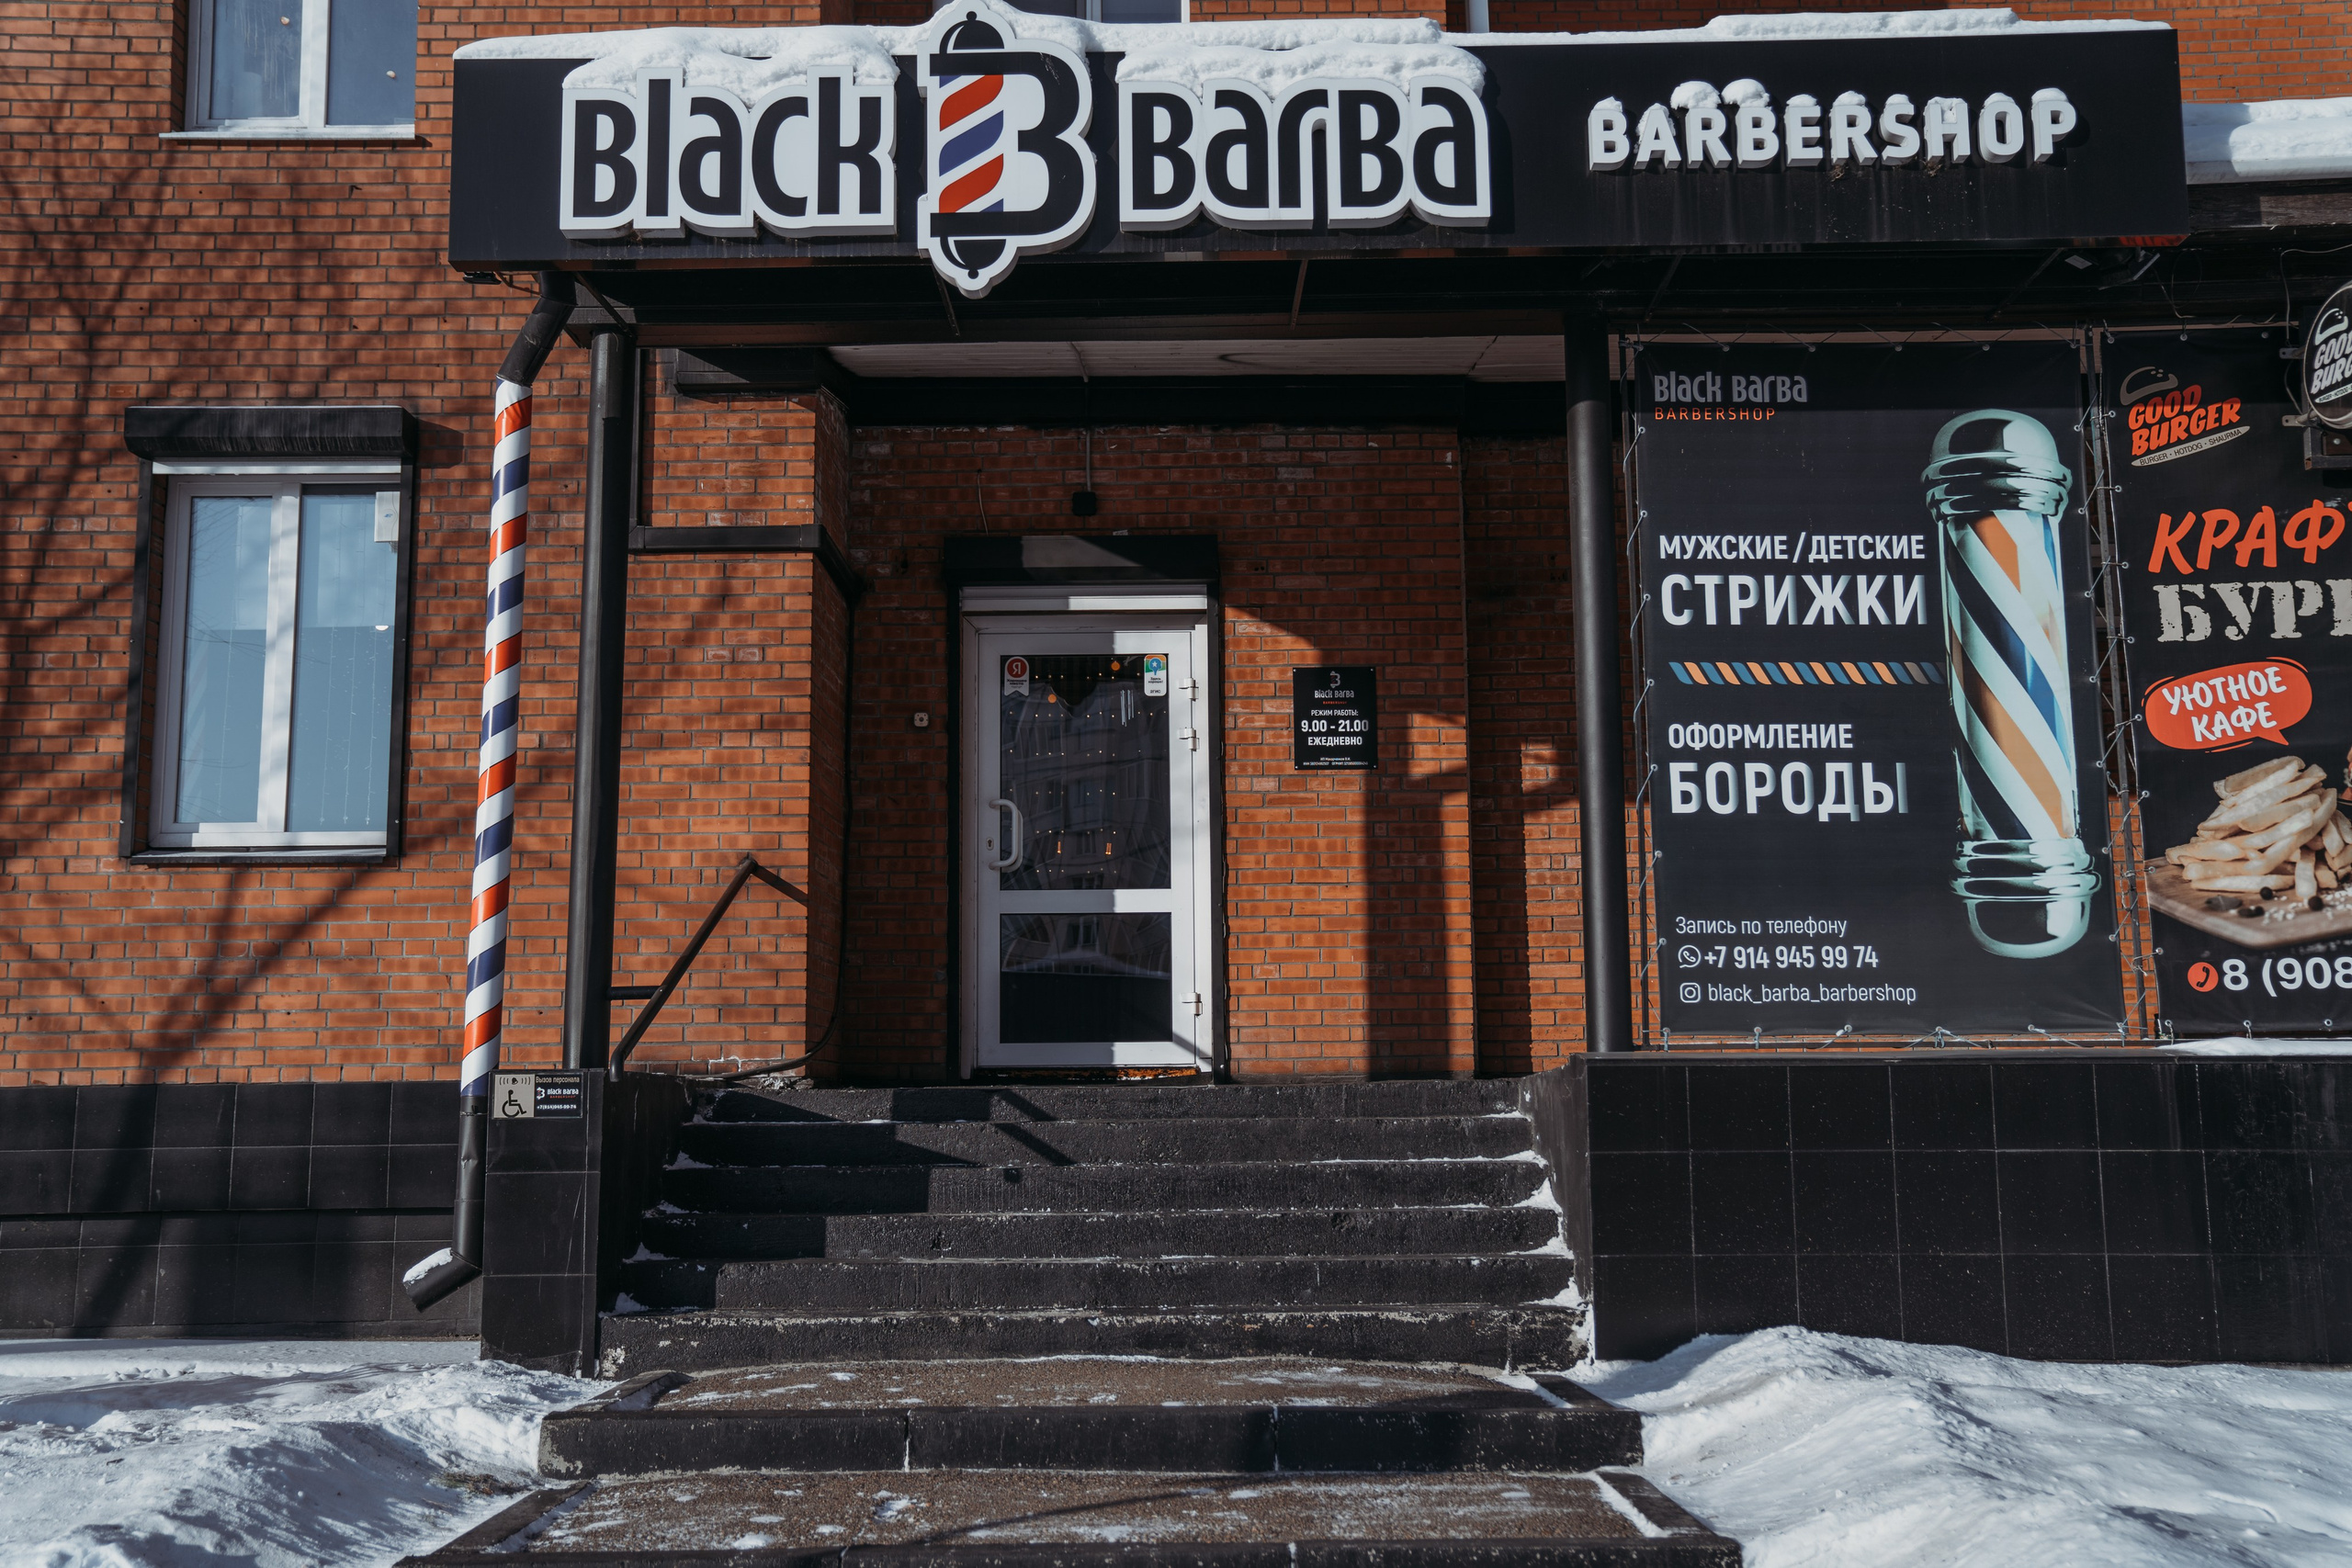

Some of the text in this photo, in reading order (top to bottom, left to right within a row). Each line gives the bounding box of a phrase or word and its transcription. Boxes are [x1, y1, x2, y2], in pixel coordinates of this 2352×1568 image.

[571, 76, 882, 219] Black
[1589, 98, 2077, 171] BARBERSHOP
[1654, 370, 1722, 403] Black
[1655, 409, 1775, 421] BARBERSHOP
[2128, 384, 2202, 431] GOOD
[2132, 397, 2242, 457] BURGER
[2139, 428, 2243, 466] BURGER HOTDOG SHAURMA
[2147, 497, 2352, 575] КРАФ
[1661, 573, 1928, 626] СТРИЖКИ
[2161, 666, 2288, 716] УЮТНОЕ
[1301, 719, 1328, 732] 9.00
[1338, 719, 1369, 732] 21.00
[1668, 721, 1854, 751] ОФОРМЛЕНИЕ
[2191, 701, 2278, 742] КАФЕ
[1307, 736, 1363, 747] ЕЖЕДНЕВНО
[1668, 761, 1908, 822] БОРОДЫ
[1675, 916, 1848, 938] Запись по телефону
[1703, 945, 1879, 969] +7 914 945 99 74
[1708, 983, 1917, 1006] black_barba_barbershop
[2222, 956, 2352, 998] 8 (908
[535, 1076, 552, 1084] Вызов
